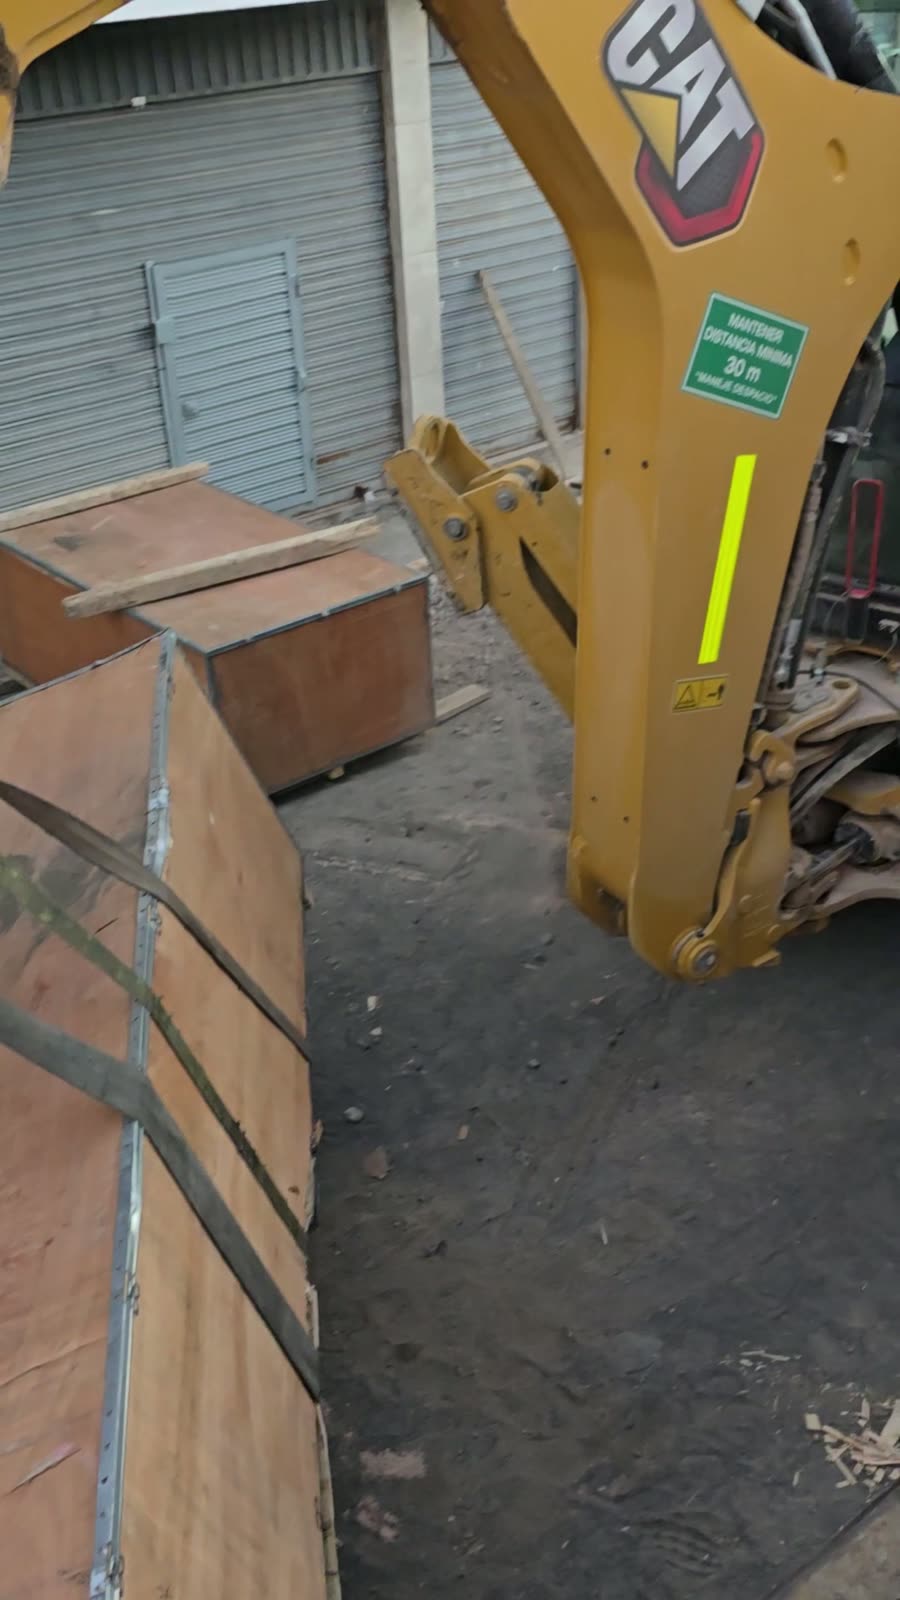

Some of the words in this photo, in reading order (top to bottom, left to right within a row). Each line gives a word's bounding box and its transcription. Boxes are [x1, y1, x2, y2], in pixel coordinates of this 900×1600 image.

[607, 0, 755, 192] CAT
[703, 325, 757, 356] DISTANCIA
[727, 312, 785, 344] MANTENER
[724, 355, 746, 377] 30
[745, 366, 761, 383] m
